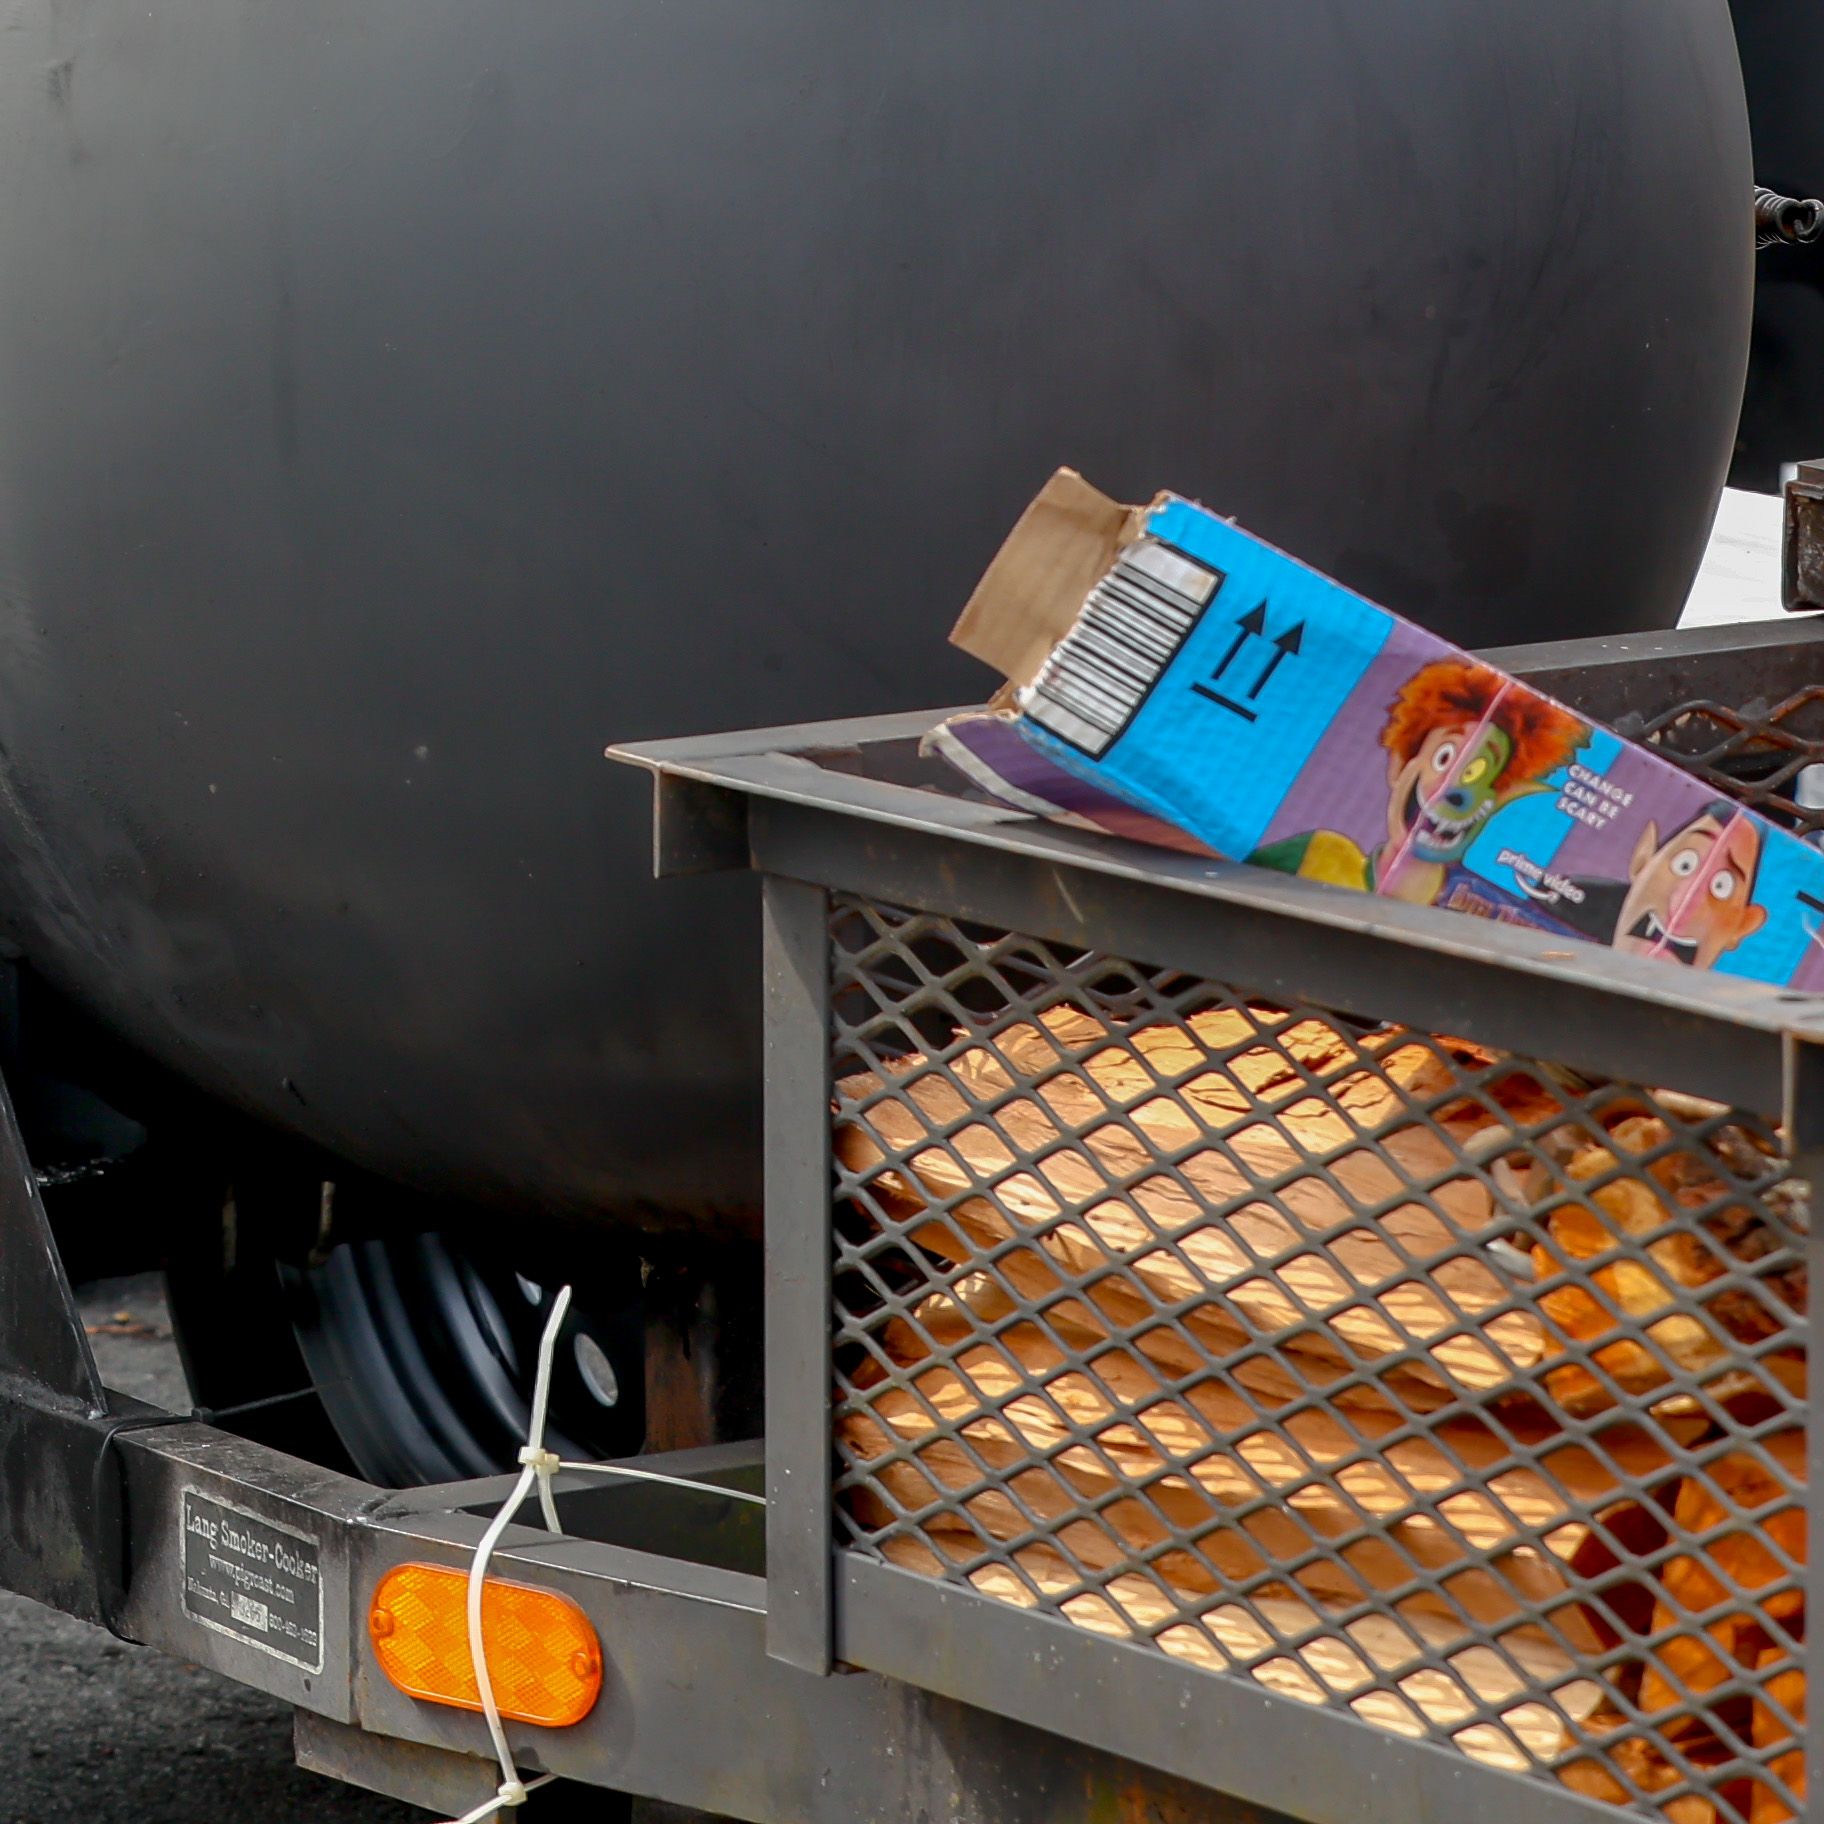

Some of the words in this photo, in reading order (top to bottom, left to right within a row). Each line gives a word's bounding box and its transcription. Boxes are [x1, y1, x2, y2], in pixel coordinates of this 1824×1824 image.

[1563, 779, 1599, 808] CAN
[1598, 800, 1621, 820] BE
[1567, 762, 1636, 808] CHANGE
[1556, 796, 1607, 830] SCARY
[1496, 848, 1545, 882] prime
[1543, 872, 1586, 904] video
[186, 1503, 219, 1550] Lang
[220, 1519, 319, 1584] Smoker-Cooker
[208, 1553, 295, 1605] www.pigroast.com
